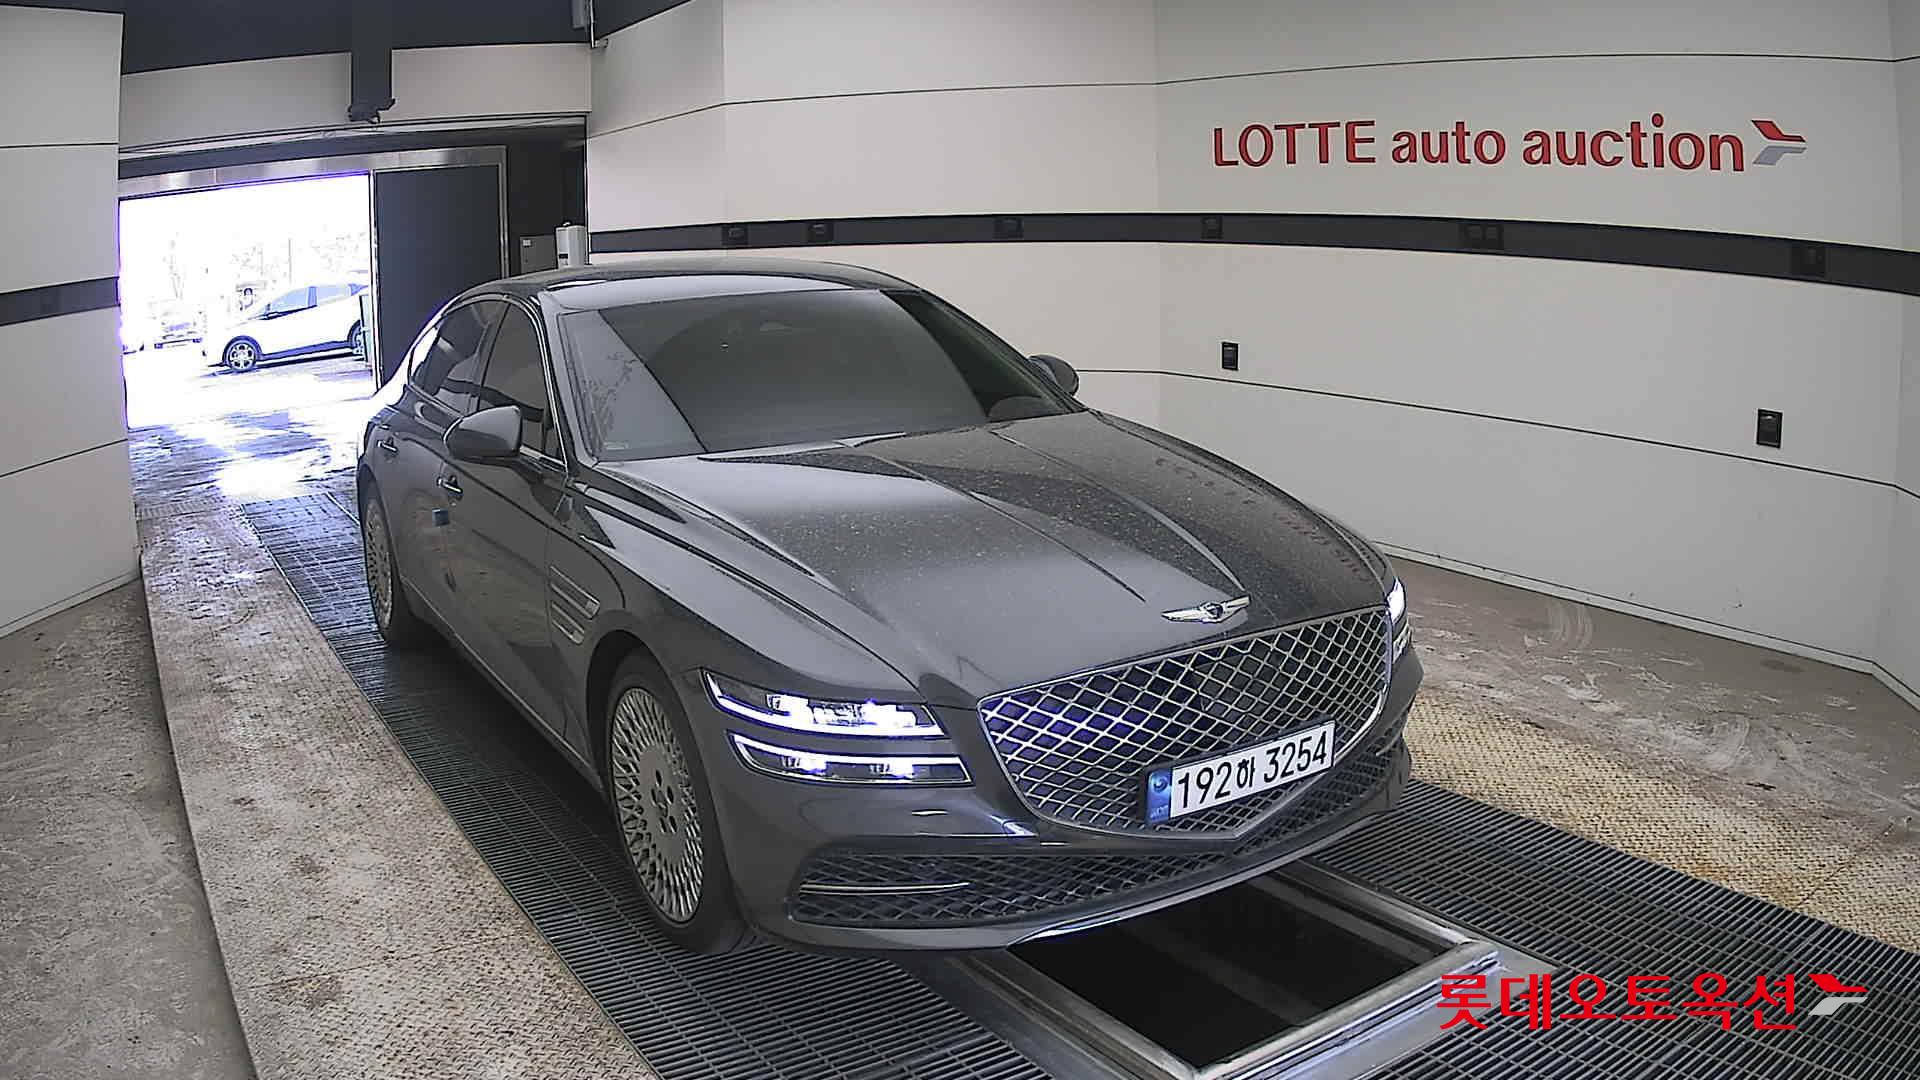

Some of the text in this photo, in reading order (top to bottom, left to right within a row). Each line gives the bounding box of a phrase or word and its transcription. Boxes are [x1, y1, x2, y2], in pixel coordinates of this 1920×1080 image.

[1213, 113, 1745, 172] LOTTE auto auction
[1177, 730, 1328, 809] 192하 3254
